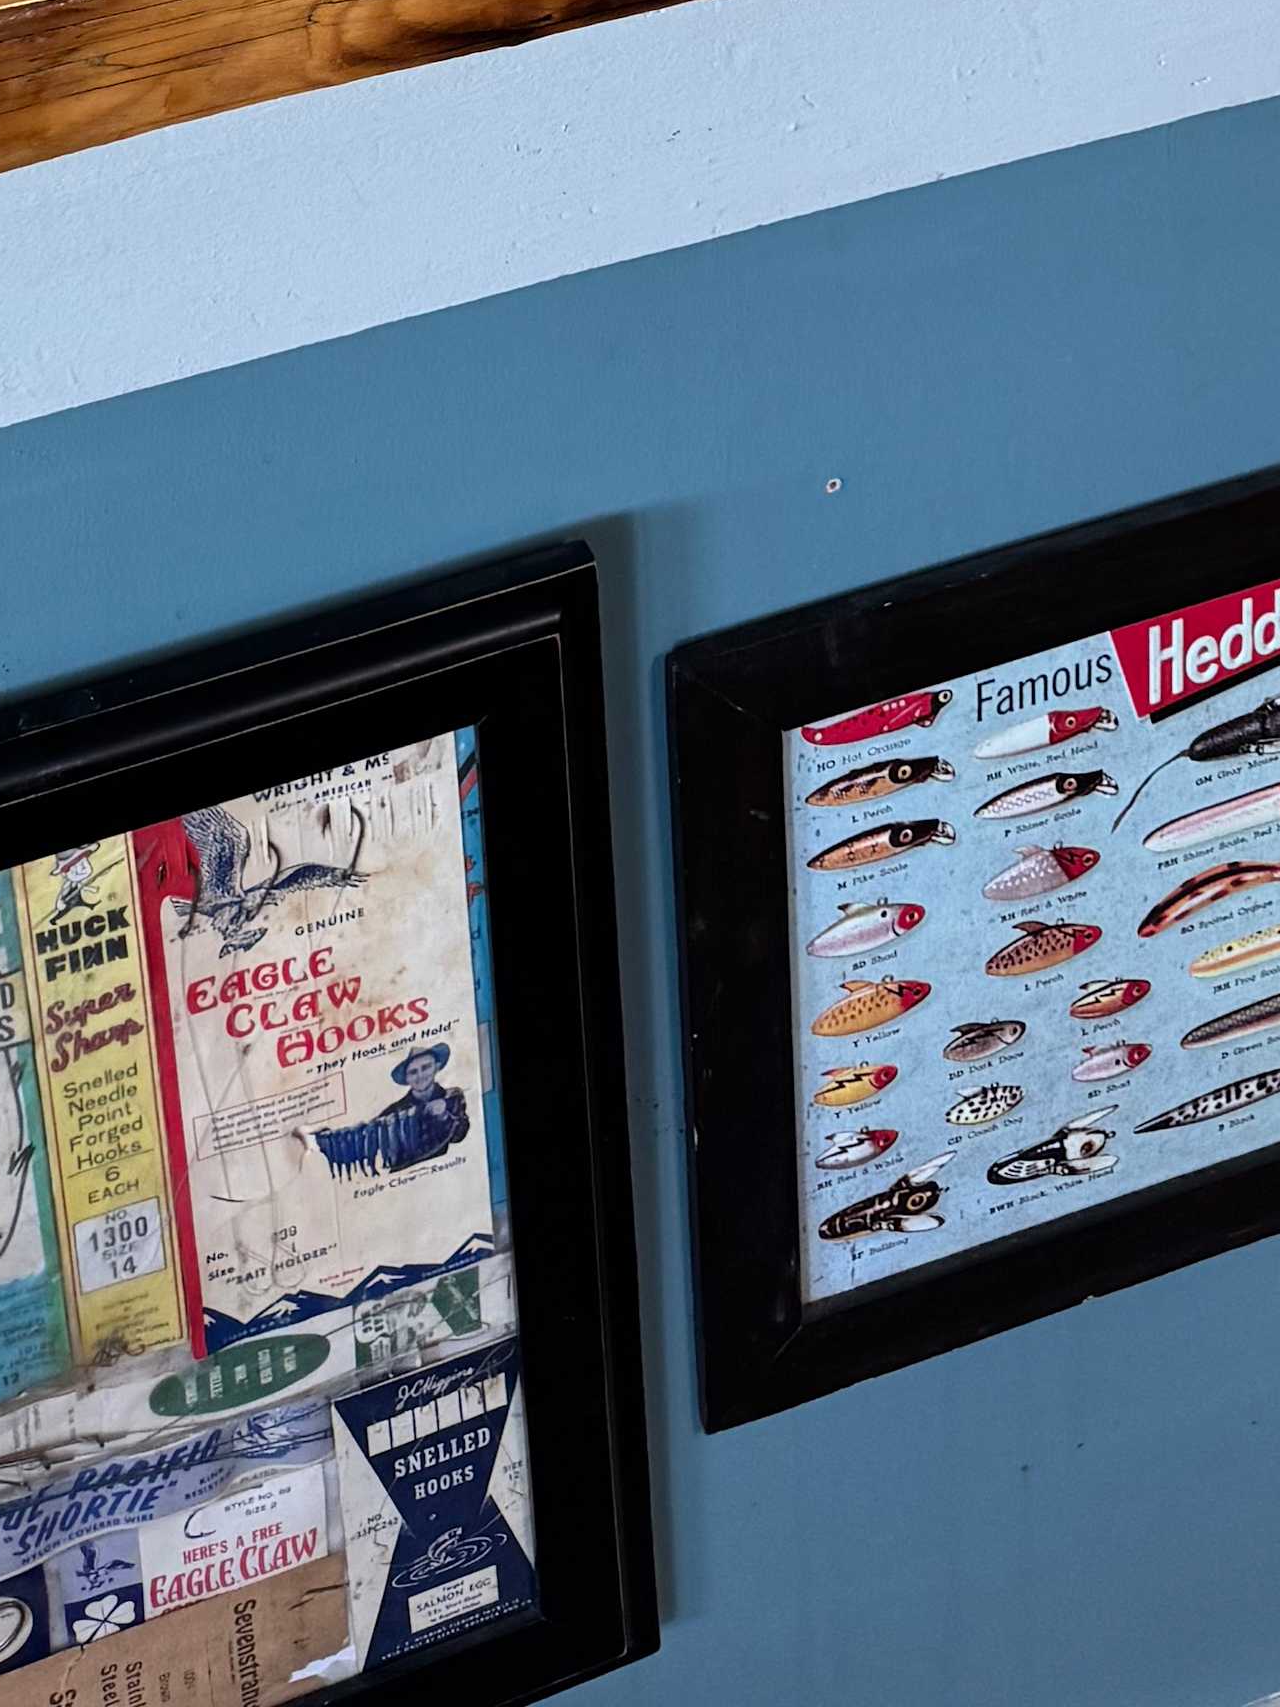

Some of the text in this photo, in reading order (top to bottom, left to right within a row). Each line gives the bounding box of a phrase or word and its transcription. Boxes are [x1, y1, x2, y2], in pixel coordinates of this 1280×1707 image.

[974, 654, 1113, 722] Famous
[867, 737, 912, 756] Orange
[36, 906, 131, 955] HUCK
[295, 908, 365, 936] GENUINE
[45, 935, 129, 982] FINN
[186, 947, 336, 1016] EAGLE
[45, 982, 136, 1034] Super
[226, 977, 361, 1038] CLAW
[51, 1017, 144, 1073] Sharp
[276, 998, 429, 1068] HOOKS
[352, 1044, 386, 1062] Hook
[391, 1034, 416, 1049] and
[64, 1062, 138, 1100] Snelled
[69, 1084, 137, 1117] Needle
[78, 1102, 131, 1131] Point
[70, 1116, 143, 1153] Forged
[77, 1141, 142, 1170] Hooks
[88, 1179, 139, 1205] EACH
[89, 1216, 148, 1252] 1300
[111, 1255, 137, 1279] 14
[395, 1427, 490, 1478] SNELLED
[414, 1465, 474, 1500] HOOKS
[183, 1521, 283, 1564] HERE'S A FREE
[150, 1528, 318, 1608] EAGLE CLAW
